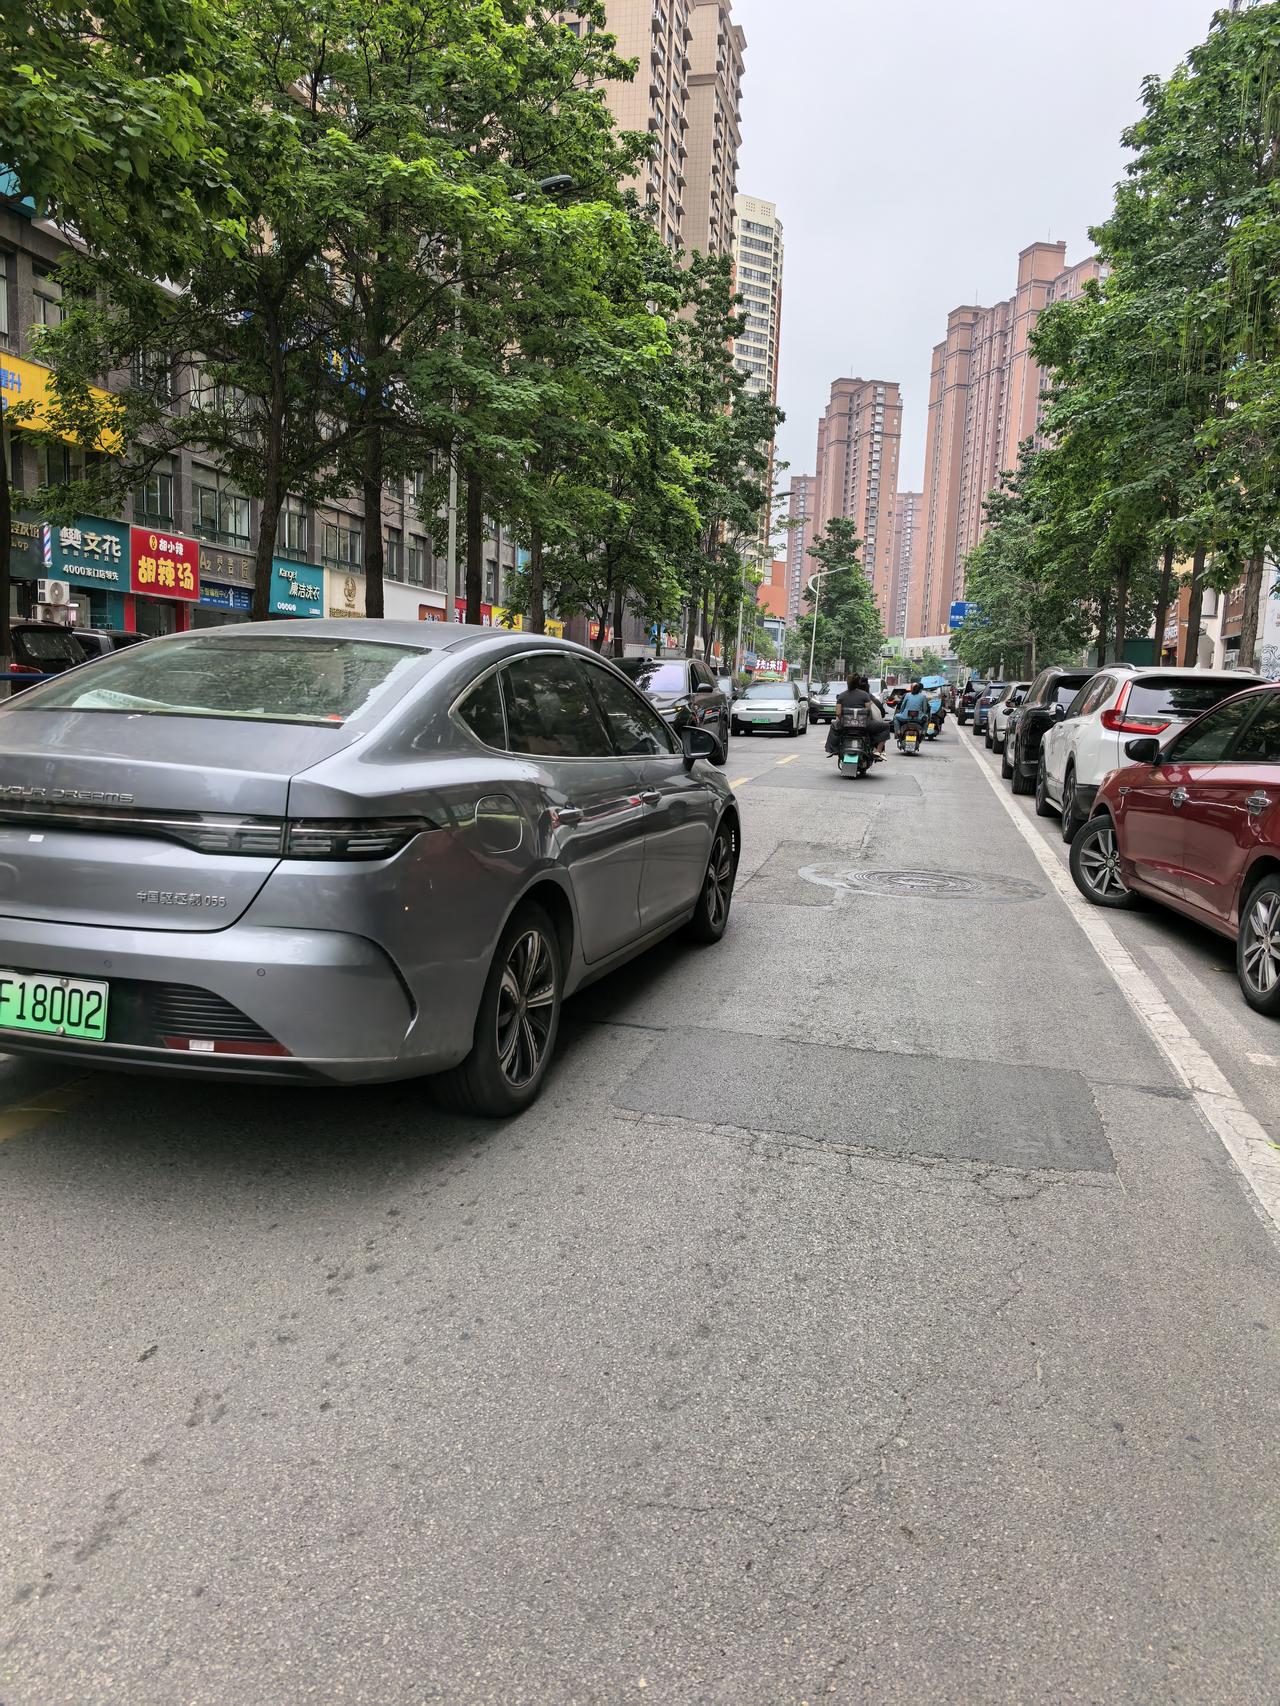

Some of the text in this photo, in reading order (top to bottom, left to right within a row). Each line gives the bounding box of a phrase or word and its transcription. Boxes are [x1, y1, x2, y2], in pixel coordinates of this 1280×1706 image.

[60, 526, 121, 557] 樊文花
[159, 538, 184, 556] 胡小辣
[63, 564, 119, 581] 4000家门店领先
[138, 555, 194, 591] 胡辣汤
[52, 788, 134, 803] DREAMS
[0, 979, 103, 1030] F18002
